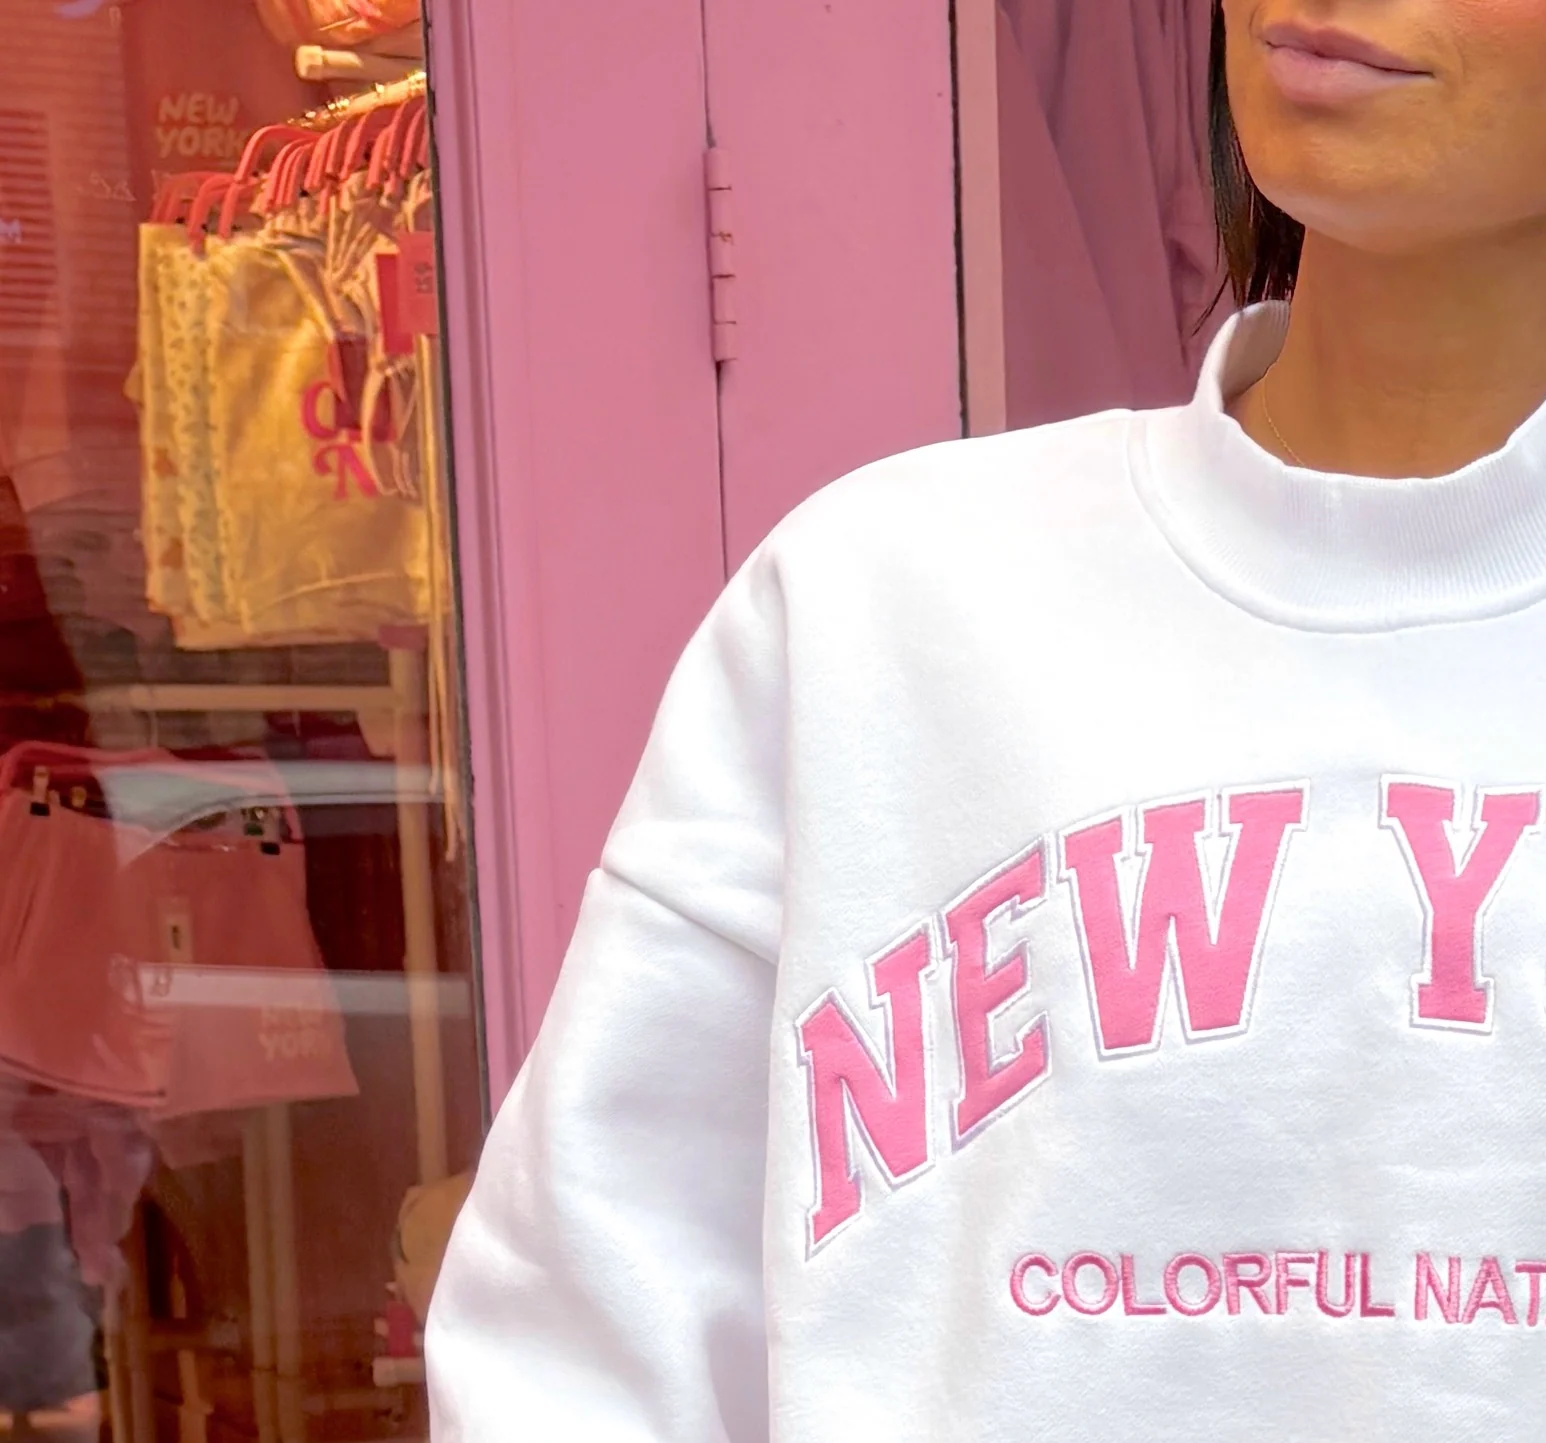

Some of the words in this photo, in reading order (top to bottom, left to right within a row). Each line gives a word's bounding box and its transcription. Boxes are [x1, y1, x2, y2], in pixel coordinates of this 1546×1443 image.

[158, 92, 240, 126] NEW
[796, 785, 1306, 1246] NEW
[1008, 1250, 1395, 1318] COLORFUL
